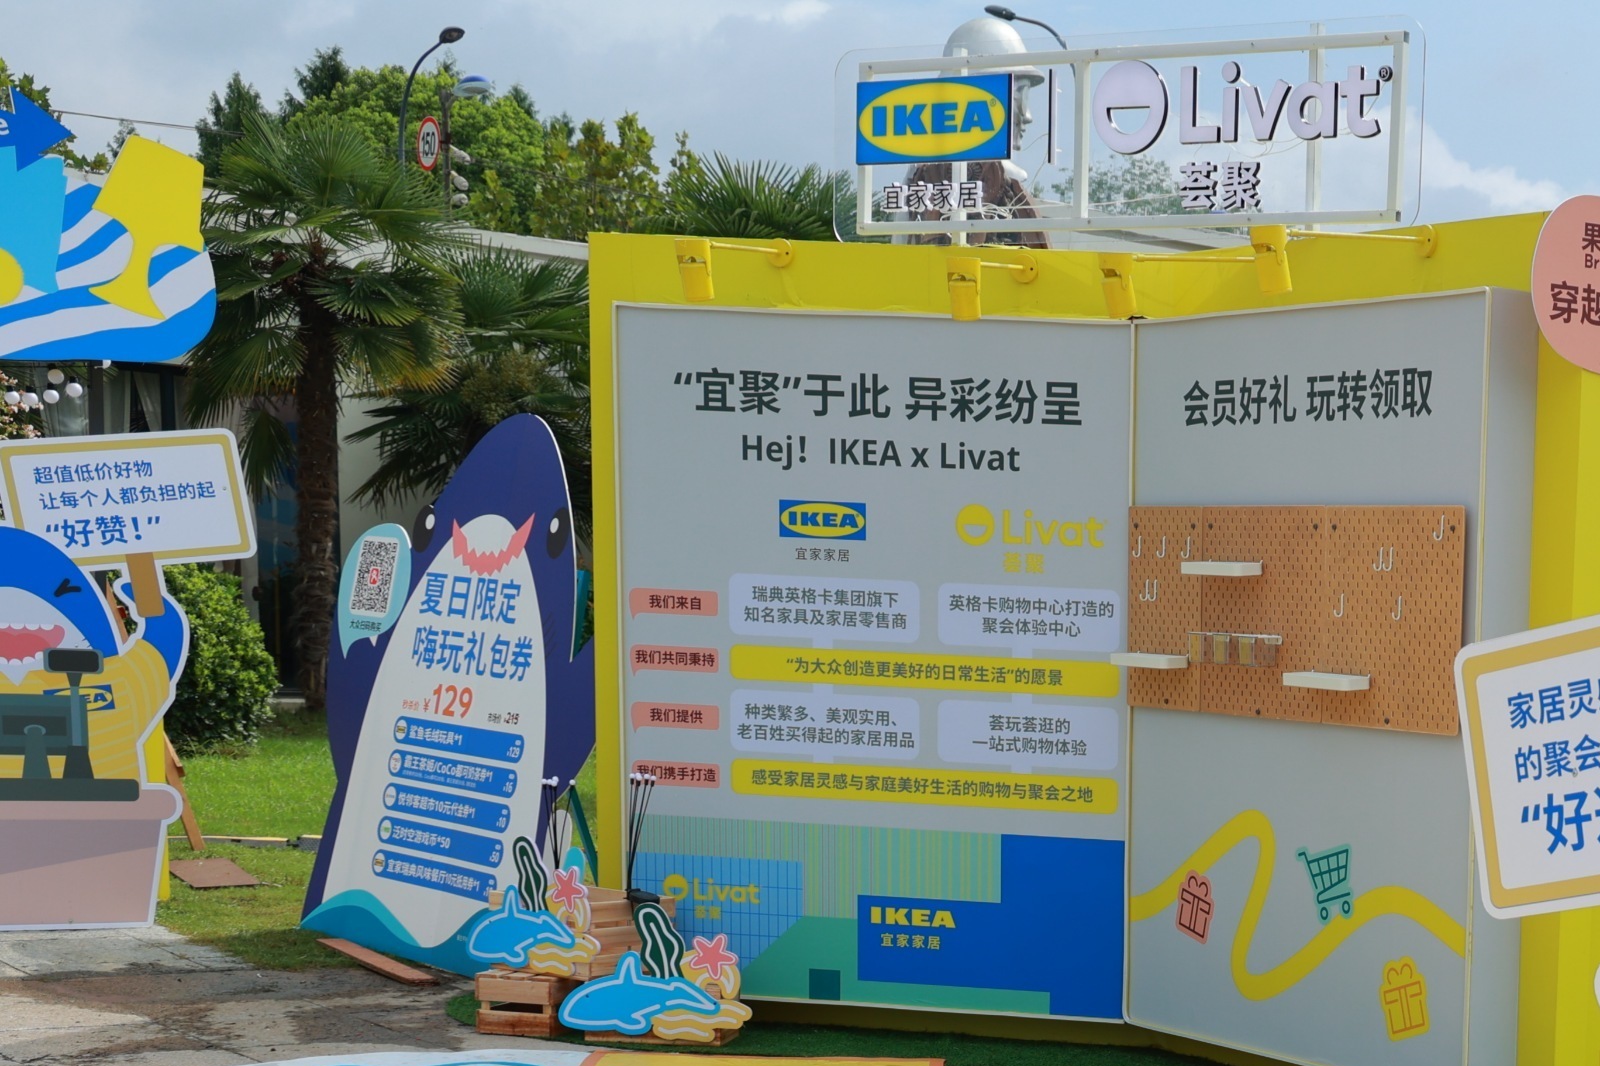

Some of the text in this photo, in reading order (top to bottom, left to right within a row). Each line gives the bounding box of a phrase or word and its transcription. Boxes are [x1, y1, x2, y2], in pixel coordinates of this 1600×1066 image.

[882, 181, 982, 211] 宜家家居
[1180, 162, 1262, 211] 荟聚
[674, 368, 1082, 426] “宜聚”于此 异彩纷呈
[1183, 367, 1432, 426] 会员好礼 玩转领取
[829, 438, 901, 467] IKEA
[911, 447, 929, 468] x
[941, 443, 1020, 472] Livat
[33, 460, 153, 485] 超值低价好物
[39, 481, 216, 510] 让每个人都负担的起
[1002, 510, 1105, 548] Livat
[795, 548, 850, 562] 宜家家居
[1003, 552, 1044, 575] 荟聚
[419, 572, 522, 625] 夏日限定
[649, 594, 702, 611] 我们来自
[752, 585, 899, 609] 瑞典英格卡集团旗下
[949, 594, 1114, 618] 英格卡购物中心打造的
[744, 605, 907, 630] 知名家具及家居零售商
[982, 617, 1081, 638] 聚会体验中心
[411, 625, 533, 682] 嗨玩礼包券
[635, 649, 715, 667] 我们共同秉持
[787, 657, 1063, 686] “为大众创造更美好的日常生活”的愿景
[650, 708, 703, 724] 我们提供
[744, 702, 897, 727] 种类繁多、美观实用、
[989, 715, 1070, 735] 荟玩荟逛的
[737, 724, 915, 749] 老百姓买得起的家居用品
[972, 735, 1087, 757] 一站式购物体验
[752, 769, 1093, 803] 感受家居灵感与家庭美好生活的购物与聚会之地
[693, 878, 761, 904] Livat
[870, 906, 956, 929] IKEA
[880, 933, 941, 950] 宜家家居
